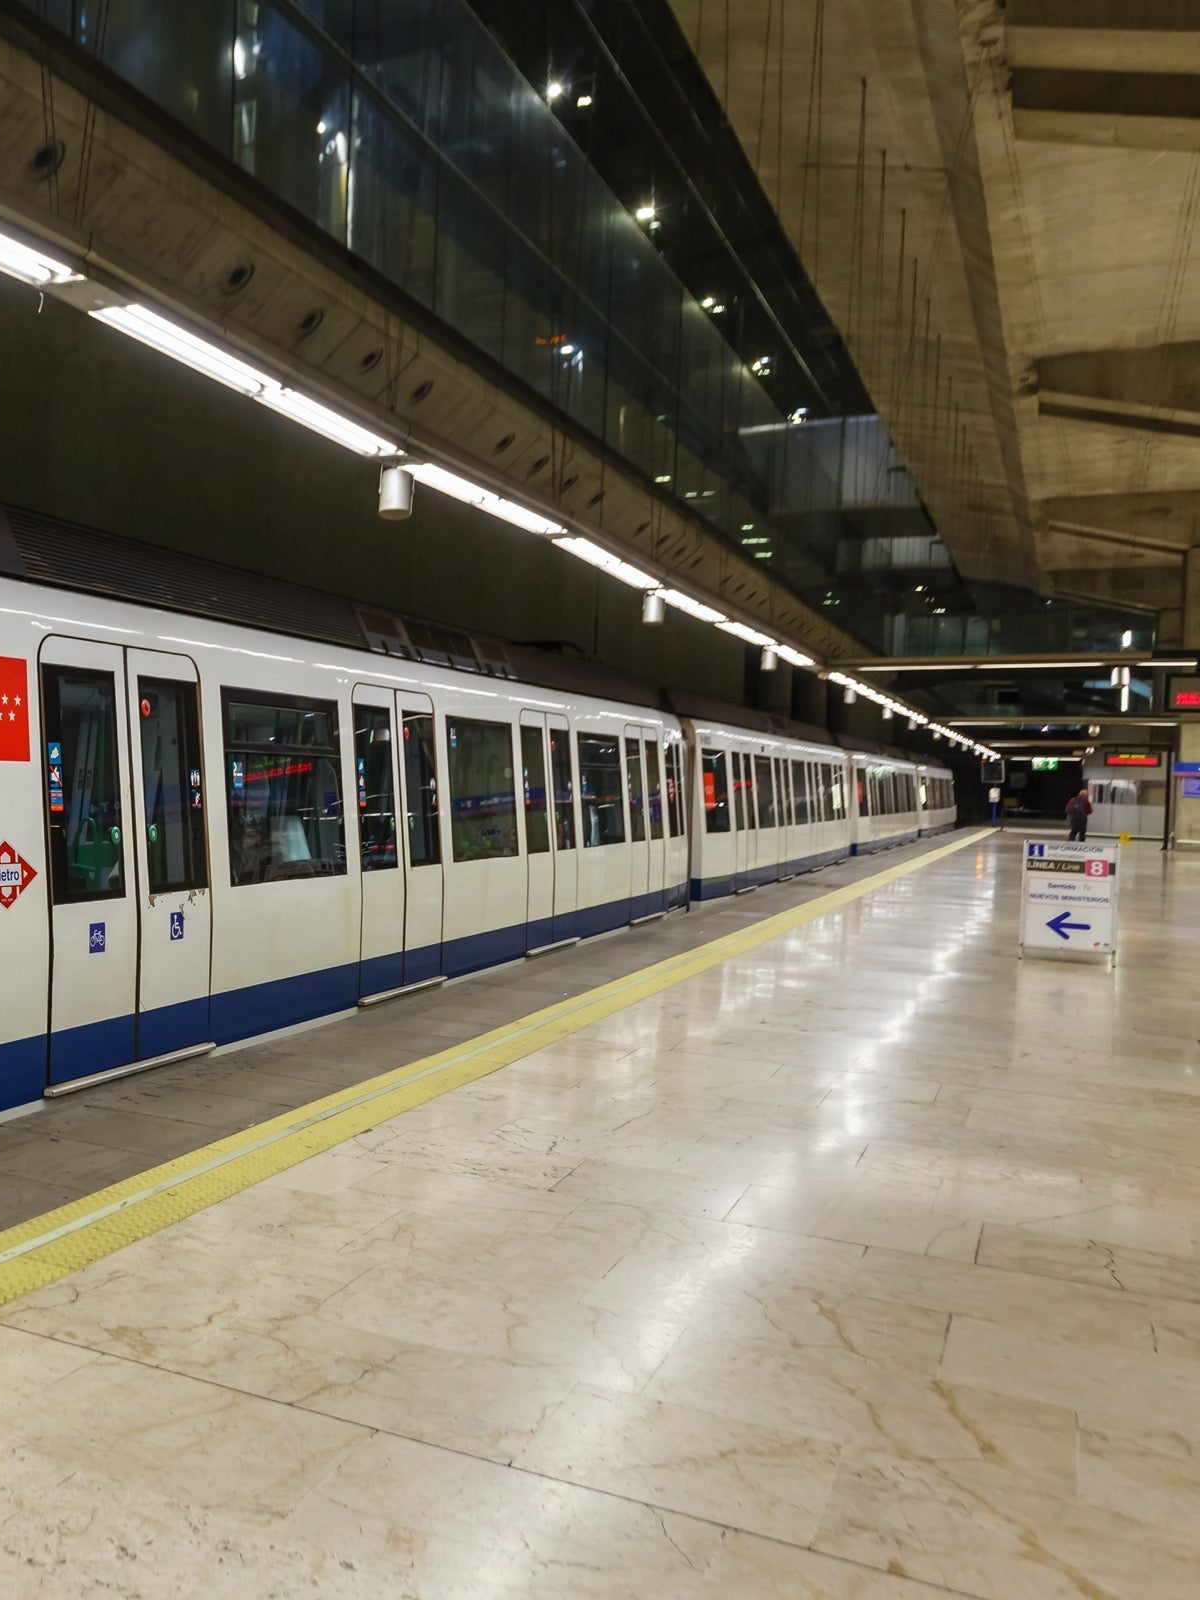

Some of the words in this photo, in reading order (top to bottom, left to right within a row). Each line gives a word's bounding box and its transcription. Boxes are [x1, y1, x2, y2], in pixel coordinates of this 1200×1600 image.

[1027, 860, 1055, 870] LÍNEA
[1061, 862, 1081, 872] Line
[1090, 861, 1104, 876] 8
[1029, 893, 1060, 901] NUEVOS
[1060, 895, 1109, 904] MINISTERIOS
